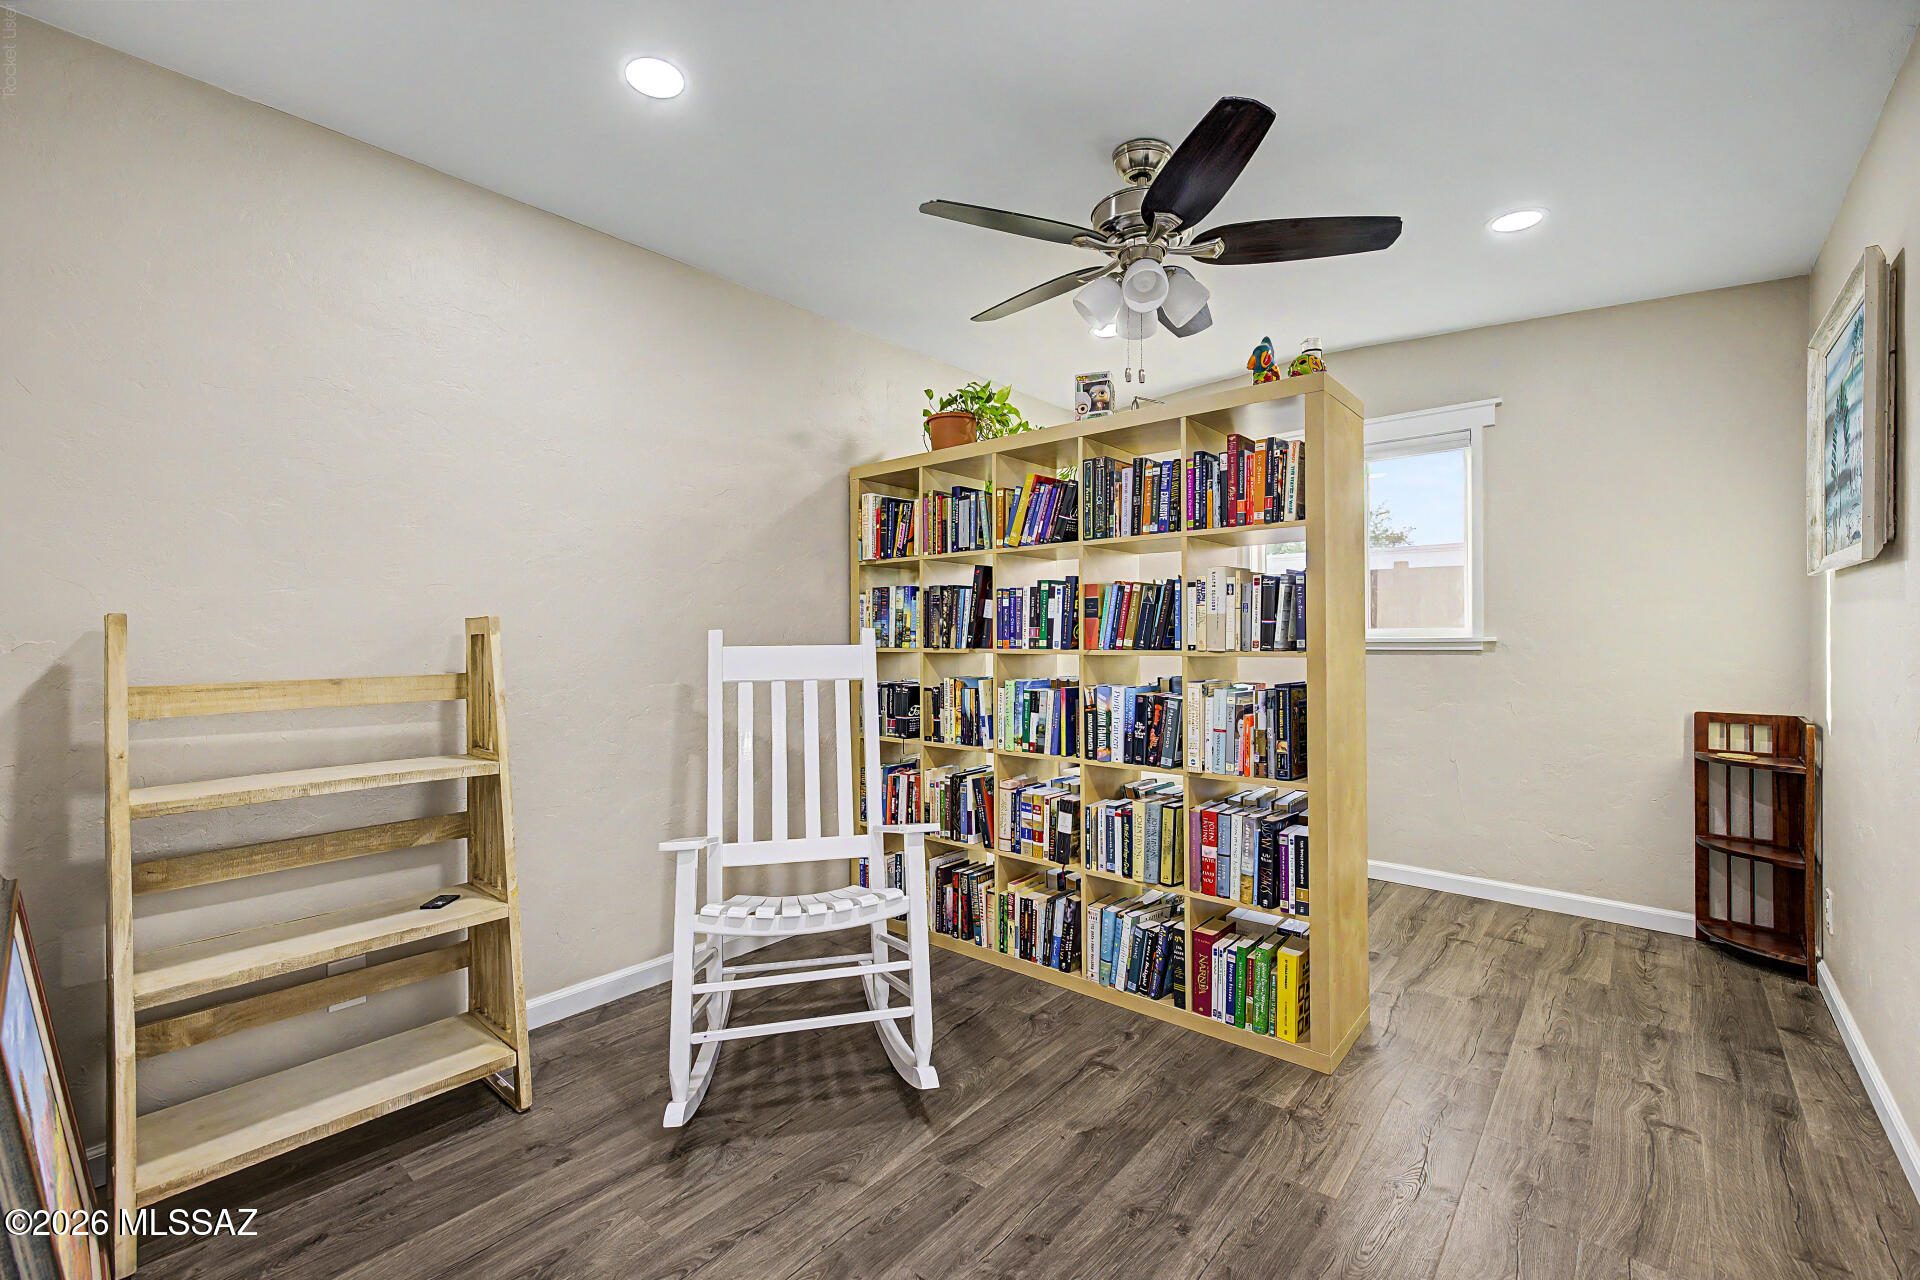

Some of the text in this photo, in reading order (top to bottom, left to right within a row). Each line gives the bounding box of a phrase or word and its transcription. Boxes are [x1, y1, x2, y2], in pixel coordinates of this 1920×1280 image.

[1159, 491, 1169, 521] EXCLUSIVE
[1112, 690, 1121, 750] Purity Franzen
[1261, 820, 1273, 896] SUSAN ISAACS
[1198, 952, 1209, 995] NARNIA
